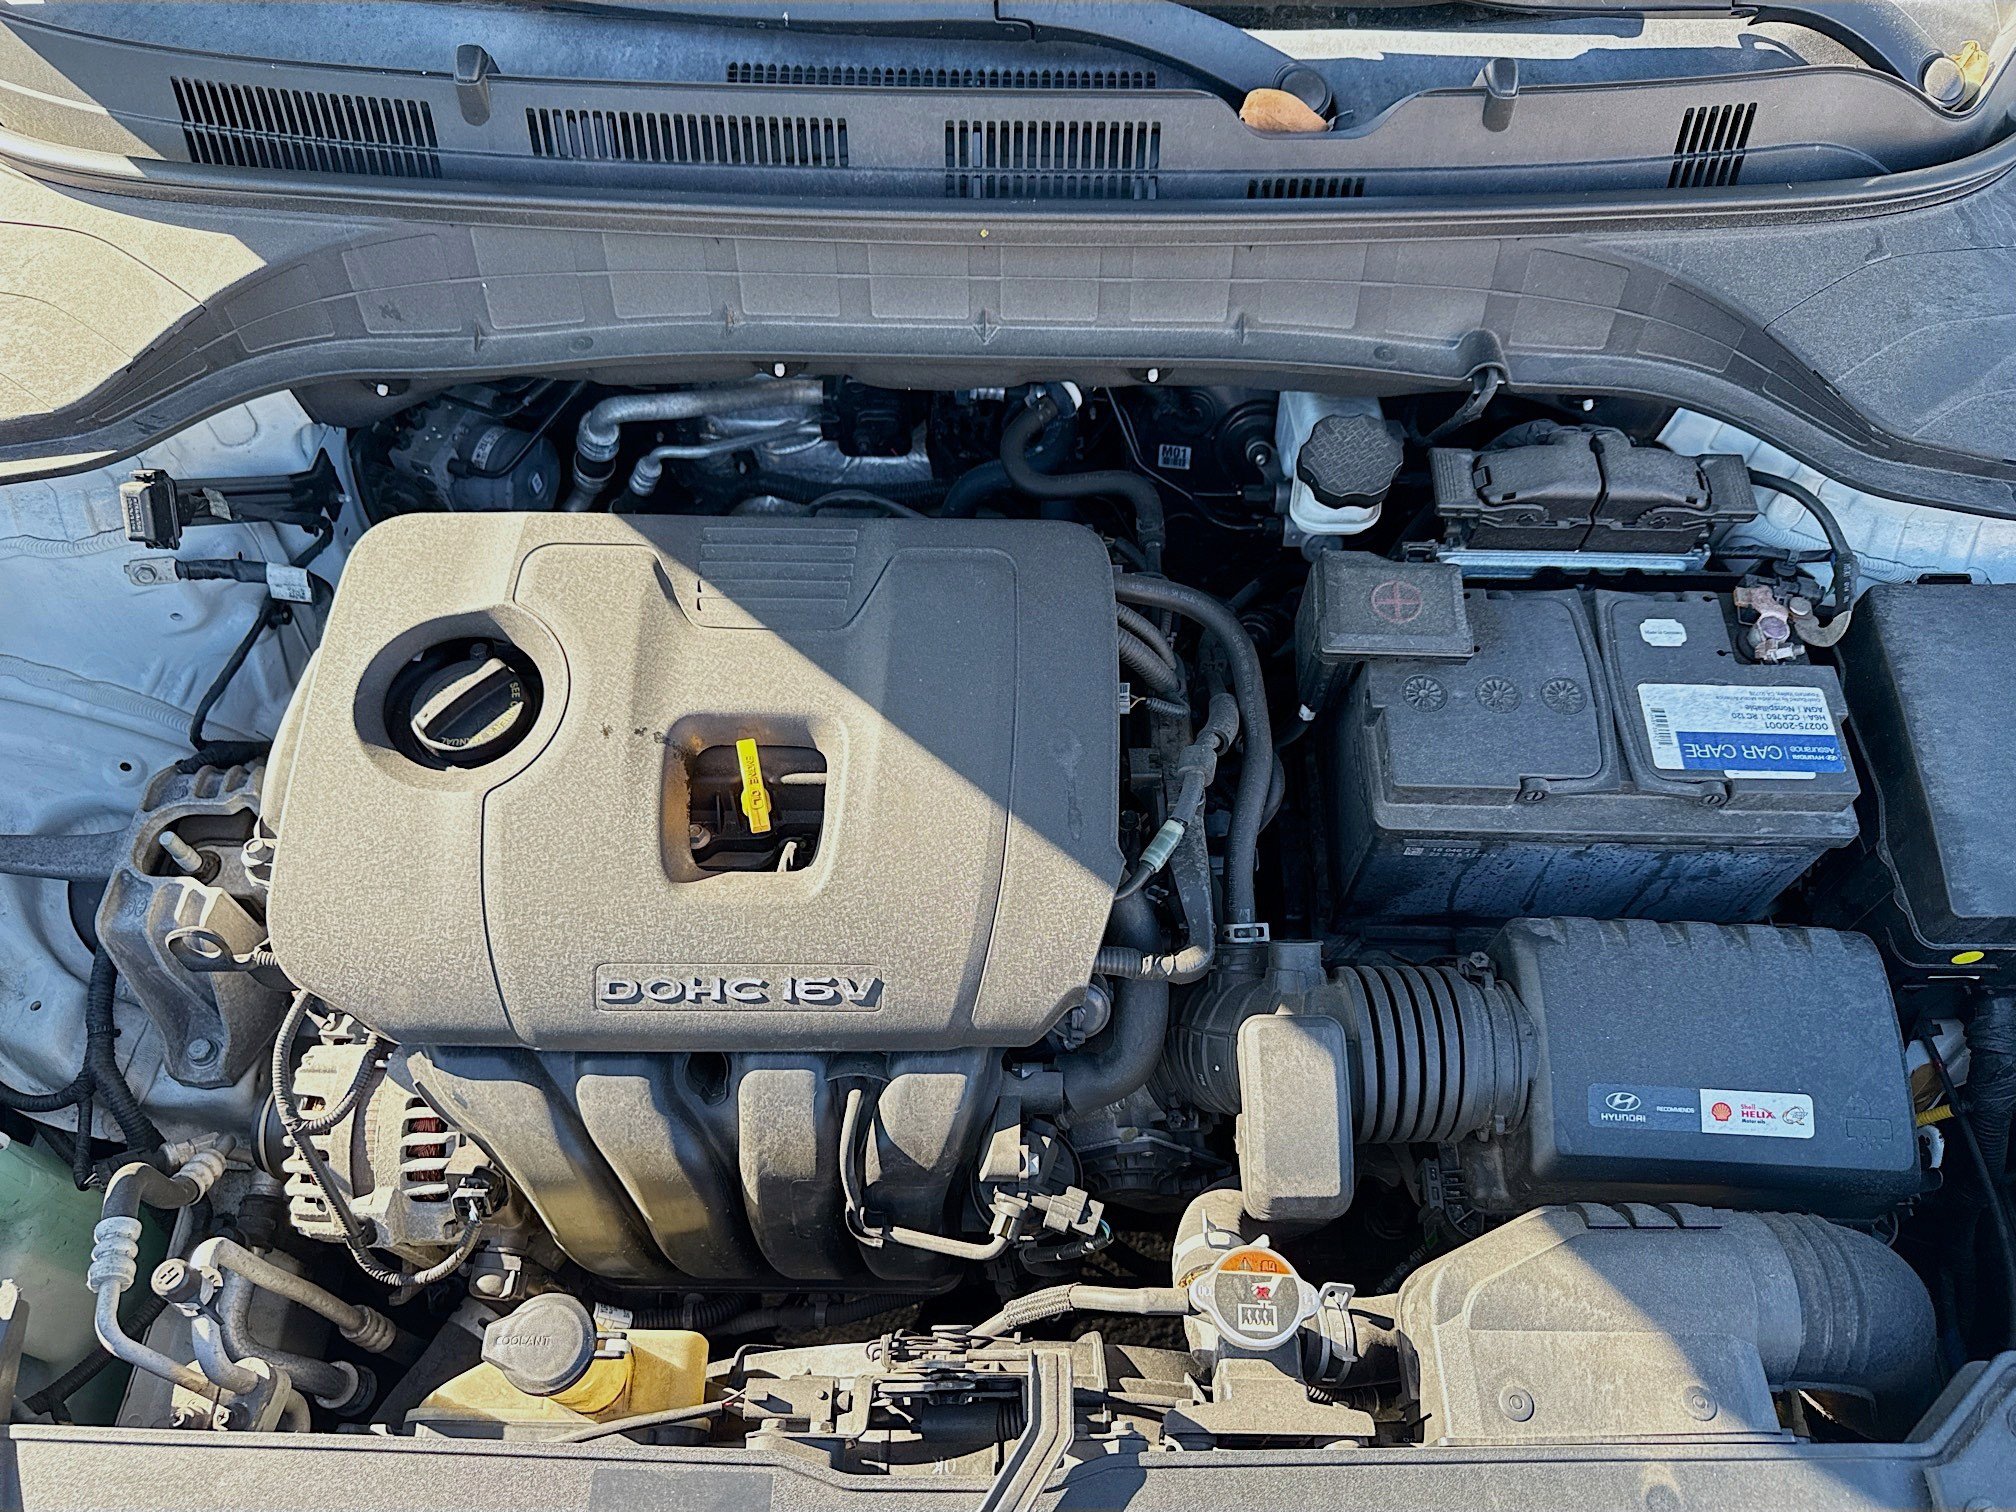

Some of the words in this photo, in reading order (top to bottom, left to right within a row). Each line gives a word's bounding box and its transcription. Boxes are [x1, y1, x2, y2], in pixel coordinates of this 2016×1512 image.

[509, 682, 520, 698] SEE
[1744, 704, 1796, 713] Nonspillable
[1765, 721, 1829, 730] 00275-20001
[1683, 743, 1737, 759] CARE
[1741, 744, 1783, 760] CAR
[1789, 745, 1835, 754] Assurance
[600, 977, 770, 1004] DOHC
[783, 977, 884, 1007] 16V
[1601, 1112, 1647, 1123] HYUNDAI
[1656, 1105, 1695, 1114] RECOMMENDS
[1741, 1110, 1774, 1119] HELIX
[496, 1335, 552, 1347] COOLANT
